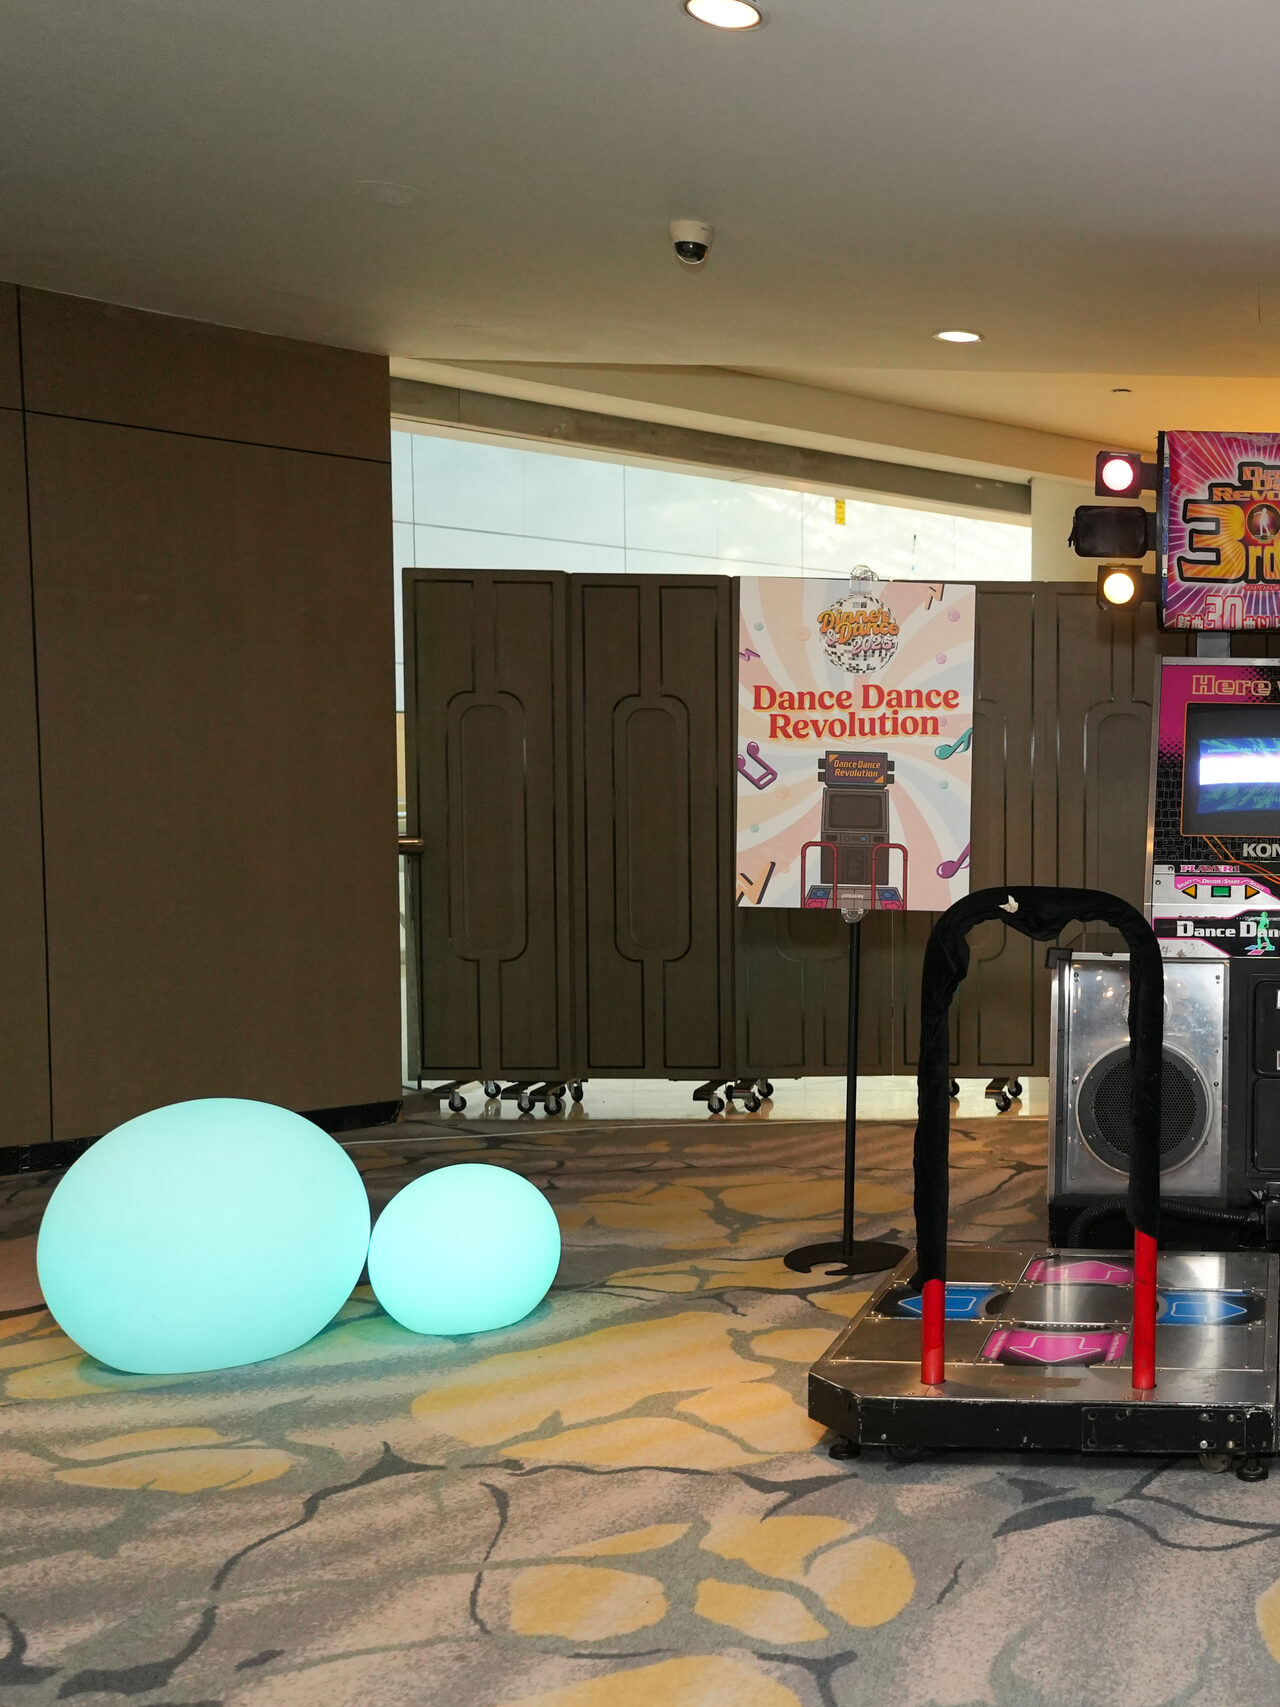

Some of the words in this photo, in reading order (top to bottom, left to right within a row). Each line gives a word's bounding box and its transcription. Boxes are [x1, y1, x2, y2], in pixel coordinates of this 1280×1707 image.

[817, 608, 891, 633] Dinner
[835, 622, 900, 644] Dance
[852, 637, 893, 655] 2025
[1192, 675, 1272, 696] Here
[752, 684, 854, 712] Dance
[861, 684, 960, 710] Dance
[768, 709, 940, 740] Revolution
[833, 759, 857, 769] Dance
[857, 760, 881, 770] Dance
[834, 768, 879, 778] Revolution
[1176, 920, 1236, 938] Dance
